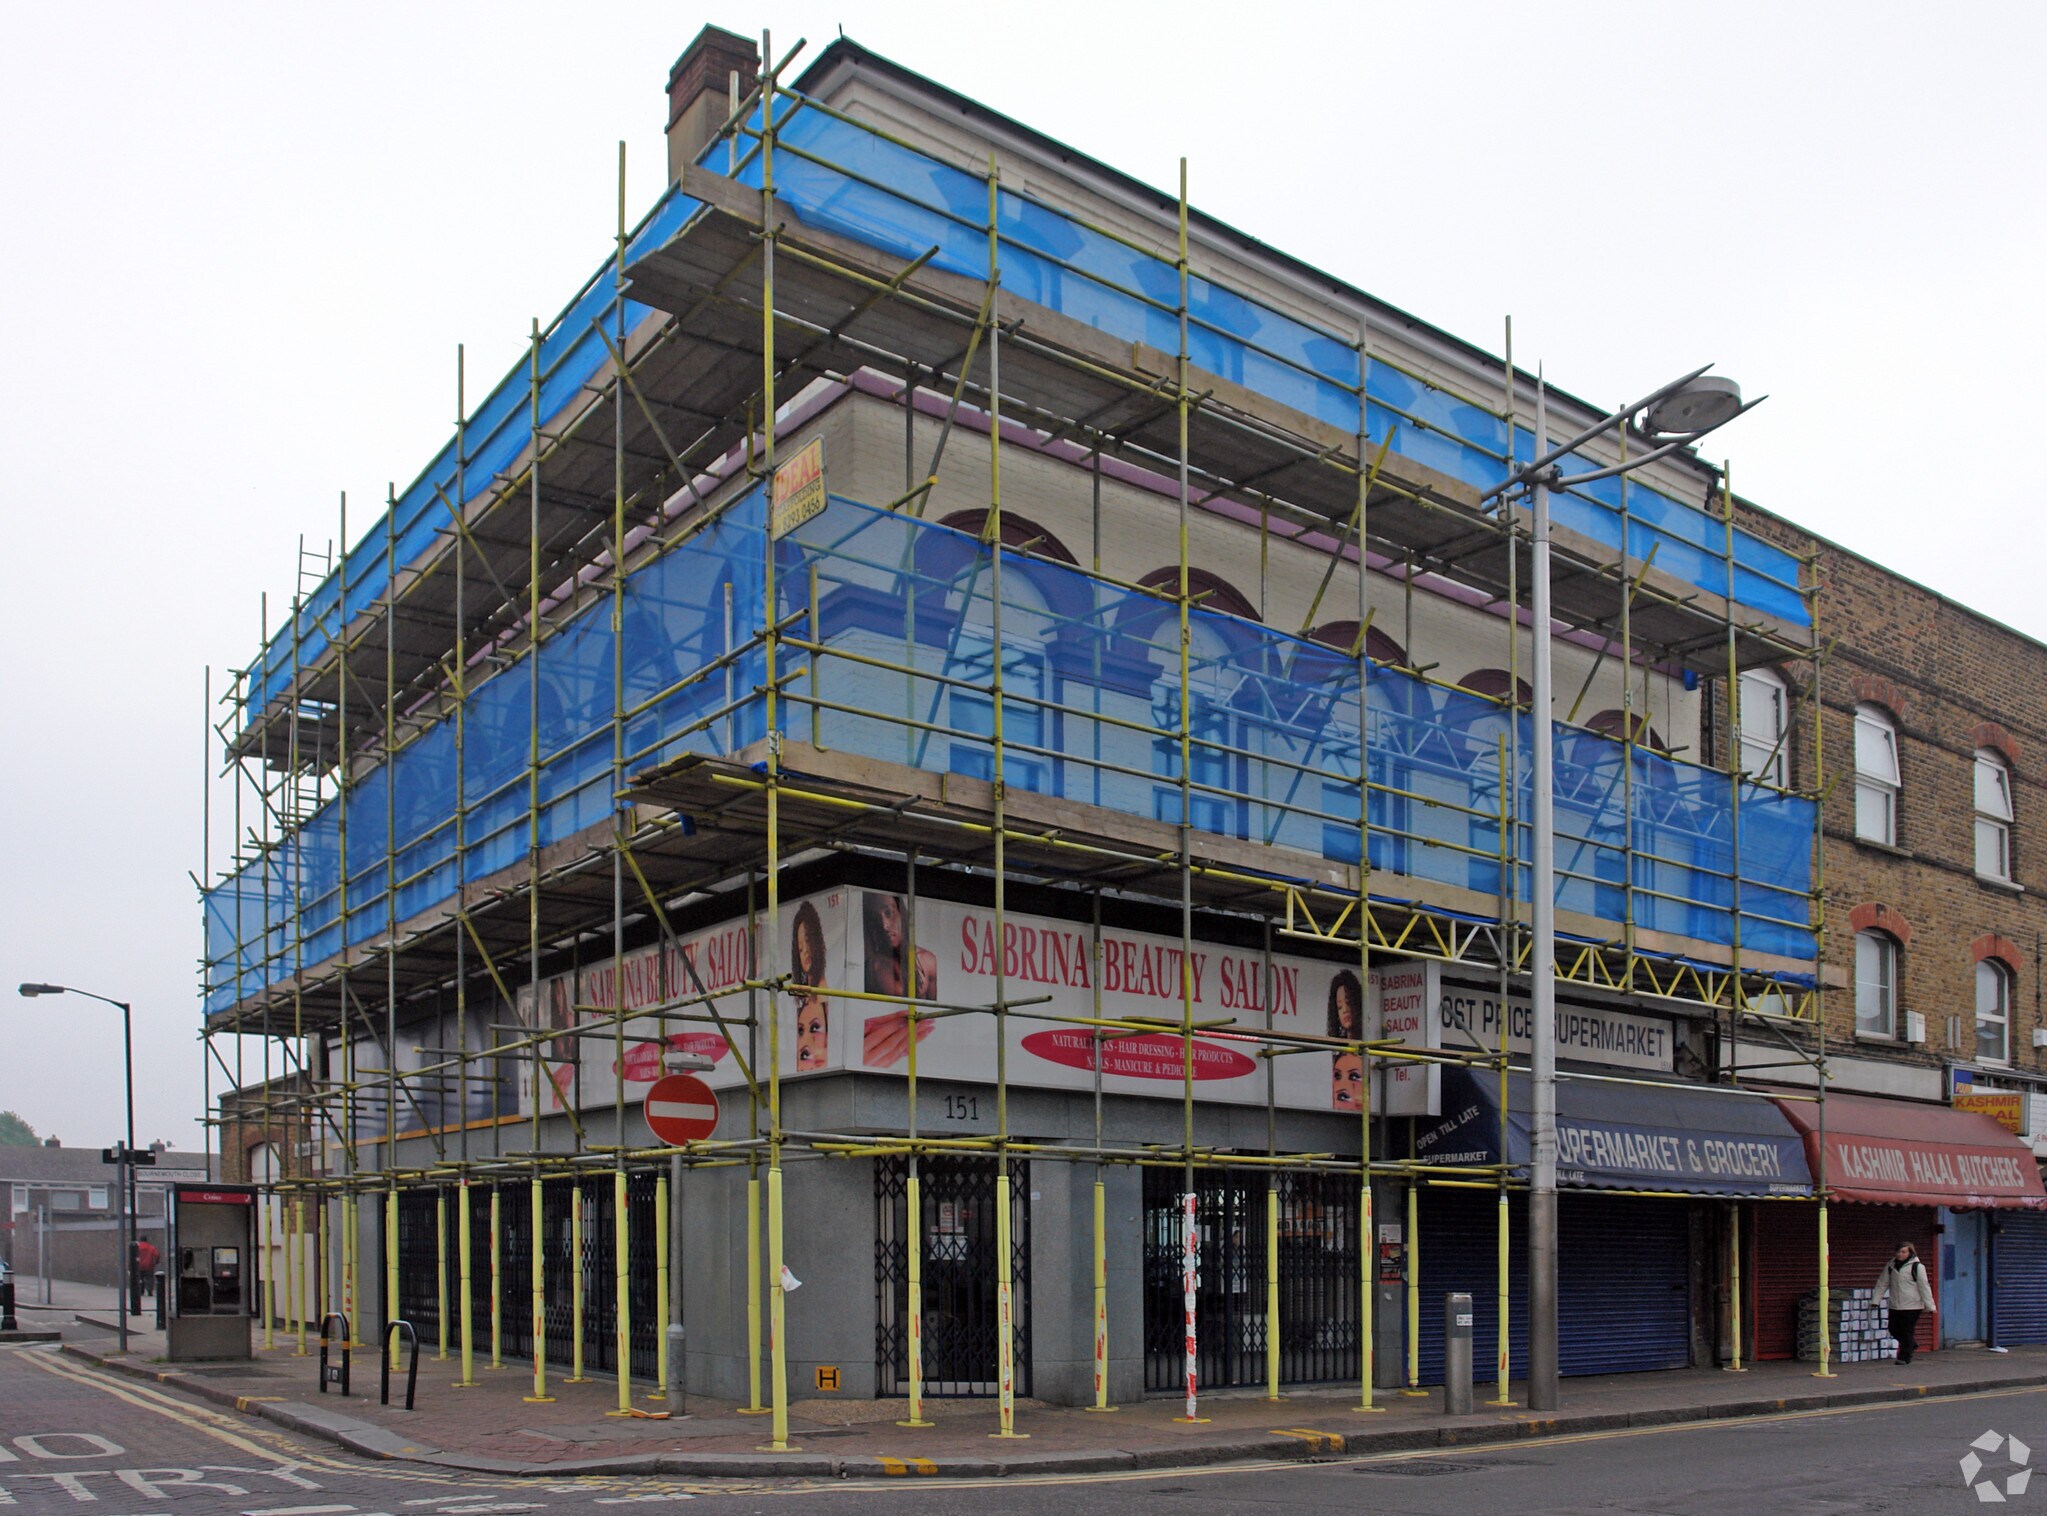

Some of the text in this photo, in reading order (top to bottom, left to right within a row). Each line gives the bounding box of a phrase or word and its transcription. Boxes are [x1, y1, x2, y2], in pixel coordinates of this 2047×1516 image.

[961, 915, 1299, 1016] SABRINA BEAUTY SALON
[590, 960, 644, 1019] SABINA
[1381, 973, 1423, 991] SABRINA
[1383, 995, 1421, 1012] BEAUTY
[1386, 1017, 1419, 1033] SALON
[1052, 1034, 1088, 1049] NATURAL
[1090, 1037, 1114, 1051] LKS
[1119, 1041, 1138, 1054] HAIR
[1139, 1043, 1175, 1058] DRESSING
[1180, 1047, 1197, 1060] HR
[1198, 1049, 1233, 1064] PRODUCTS
[1086, 1056, 1109, 1070] NLS
[1114, 1059, 1153, 1074] MANICURE
[1162, 1063, 1198, 1077] PEDICE
[944, 1095, 979, 1120] 151
[1955, 1096, 2020, 1108] KASHMIR
[1416, 1105, 1480, 1150] OPEN TILL LATE
[1423, 1151, 1487, 1164] SUPERMARKET
[1555, 1127, 1781, 1177] UPERMARKET & GROCERY
[138, 1170, 182, 1178] BOURNEMOUTH
[1838, 1144, 2024, 1187] KASHMIR HALAL BUTCHERS
[820, 1369, 836, 1388] H
